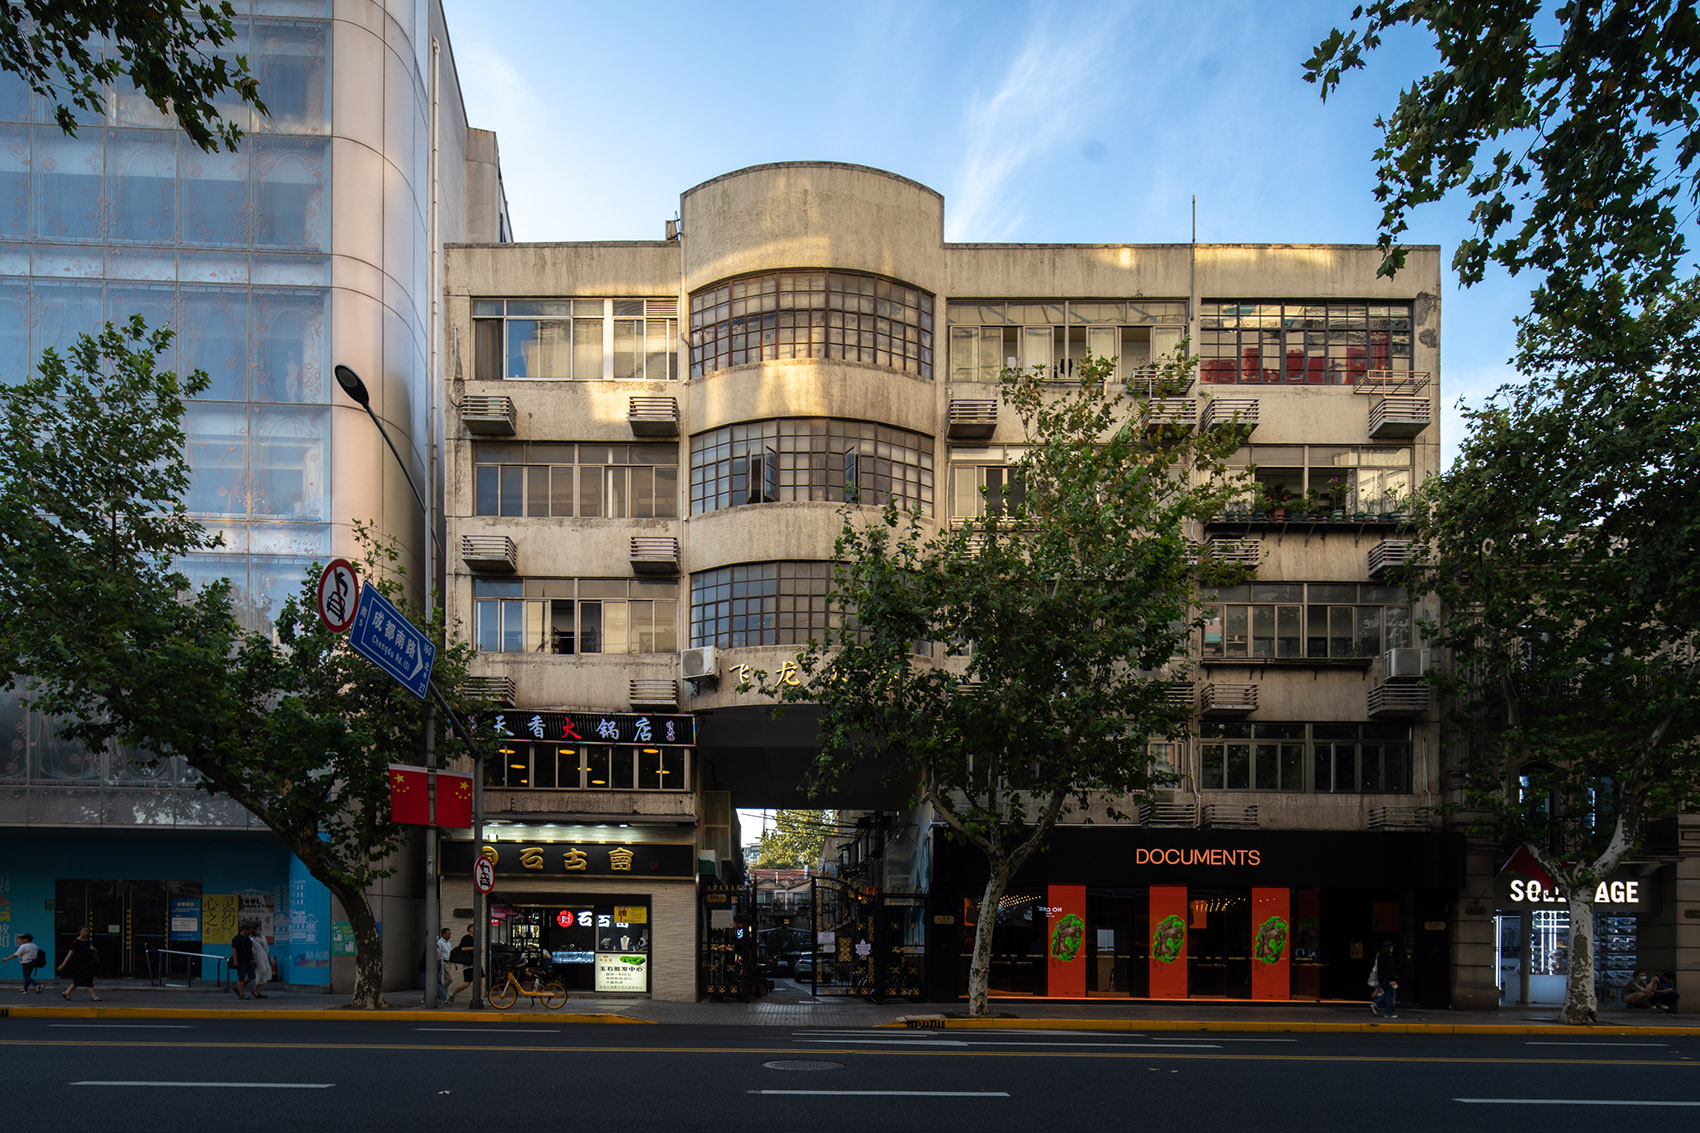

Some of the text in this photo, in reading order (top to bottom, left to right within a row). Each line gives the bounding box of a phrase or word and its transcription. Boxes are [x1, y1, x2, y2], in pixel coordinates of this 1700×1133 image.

[360, 605, 368, 618] 南
[371, 611, 417, 660] 成都南路
[372, 635, 394, 661] Chengdu
[395, 654, 404, 667] Rd.
[418, 682, 426, 694] 27
[1136, 848, 1261, 866] DOCUMENTS
[204, 896, 234, 910] 心灵
[204, 912, 235, 928] 之约
